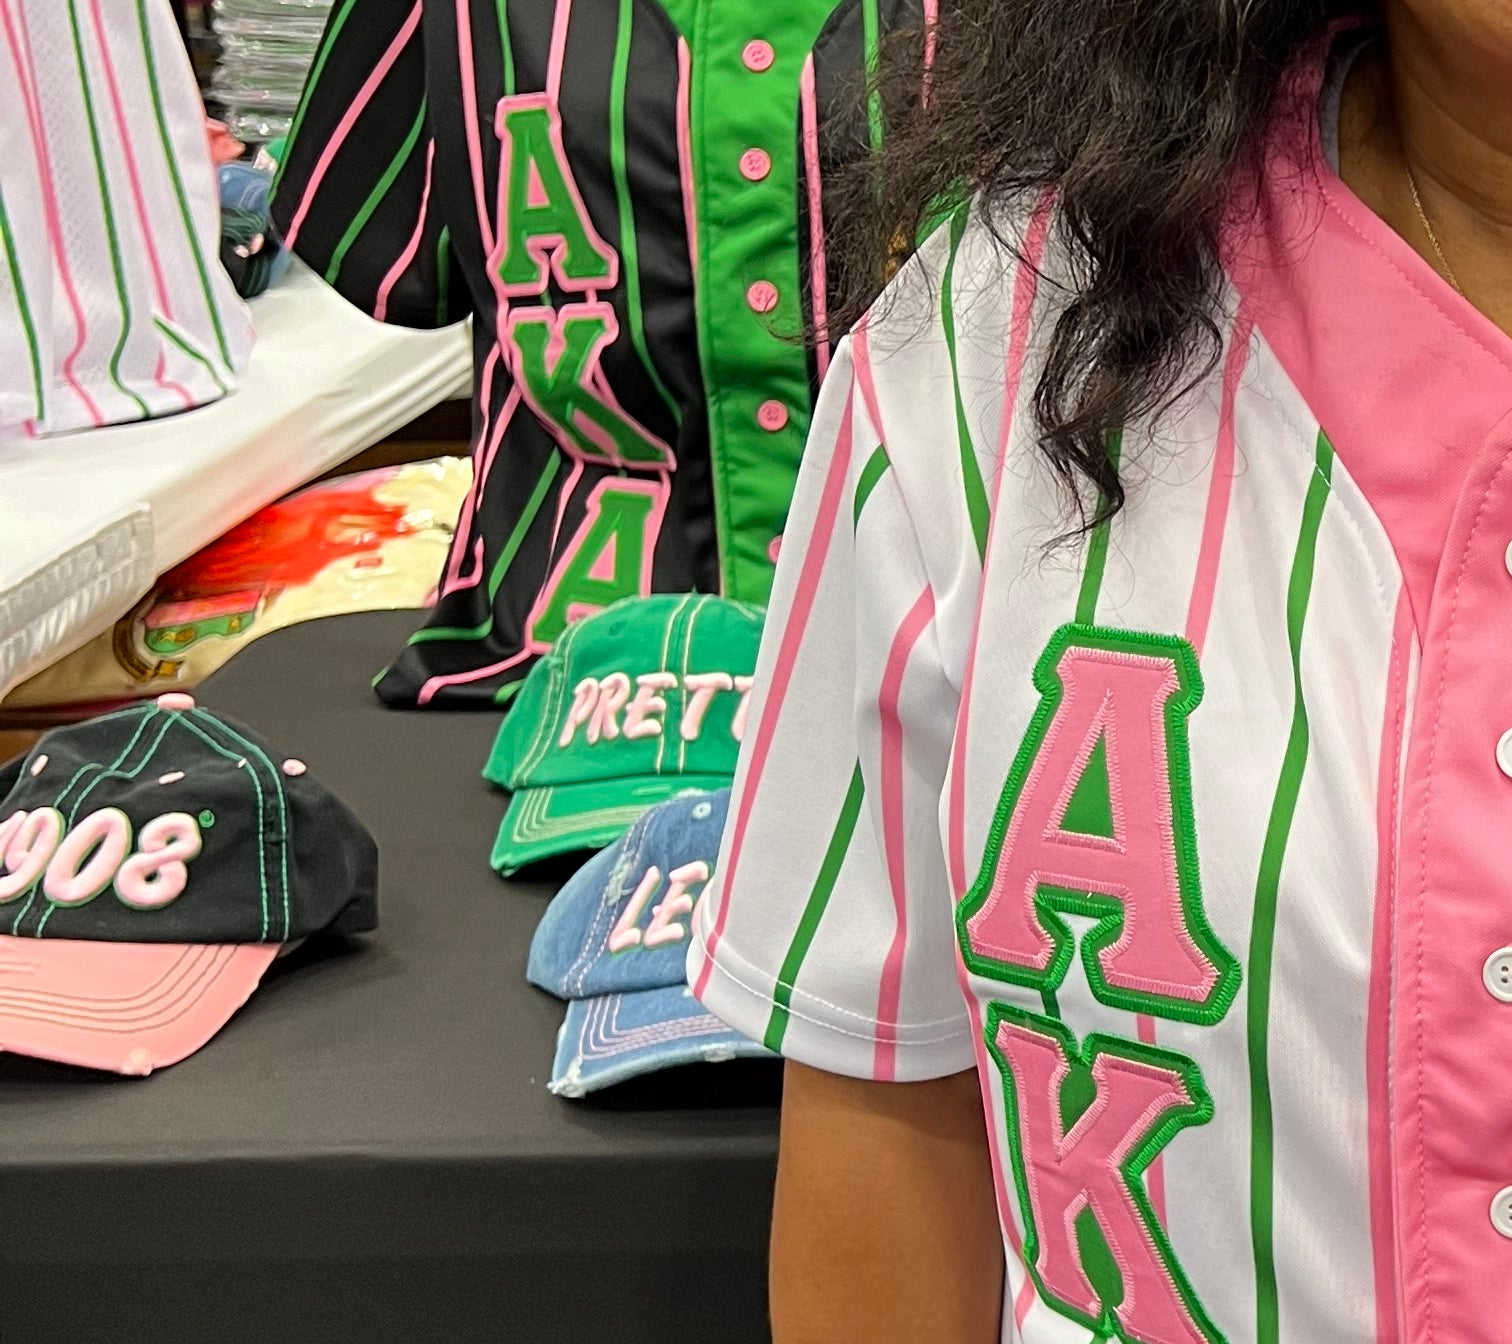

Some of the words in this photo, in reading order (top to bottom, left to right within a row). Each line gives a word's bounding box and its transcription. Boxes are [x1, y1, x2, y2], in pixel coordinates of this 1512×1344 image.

[488, 93, 676, 652] AKA
[559, 671, 755, 748] PRETT
[608, 860, 713, 958] LE
